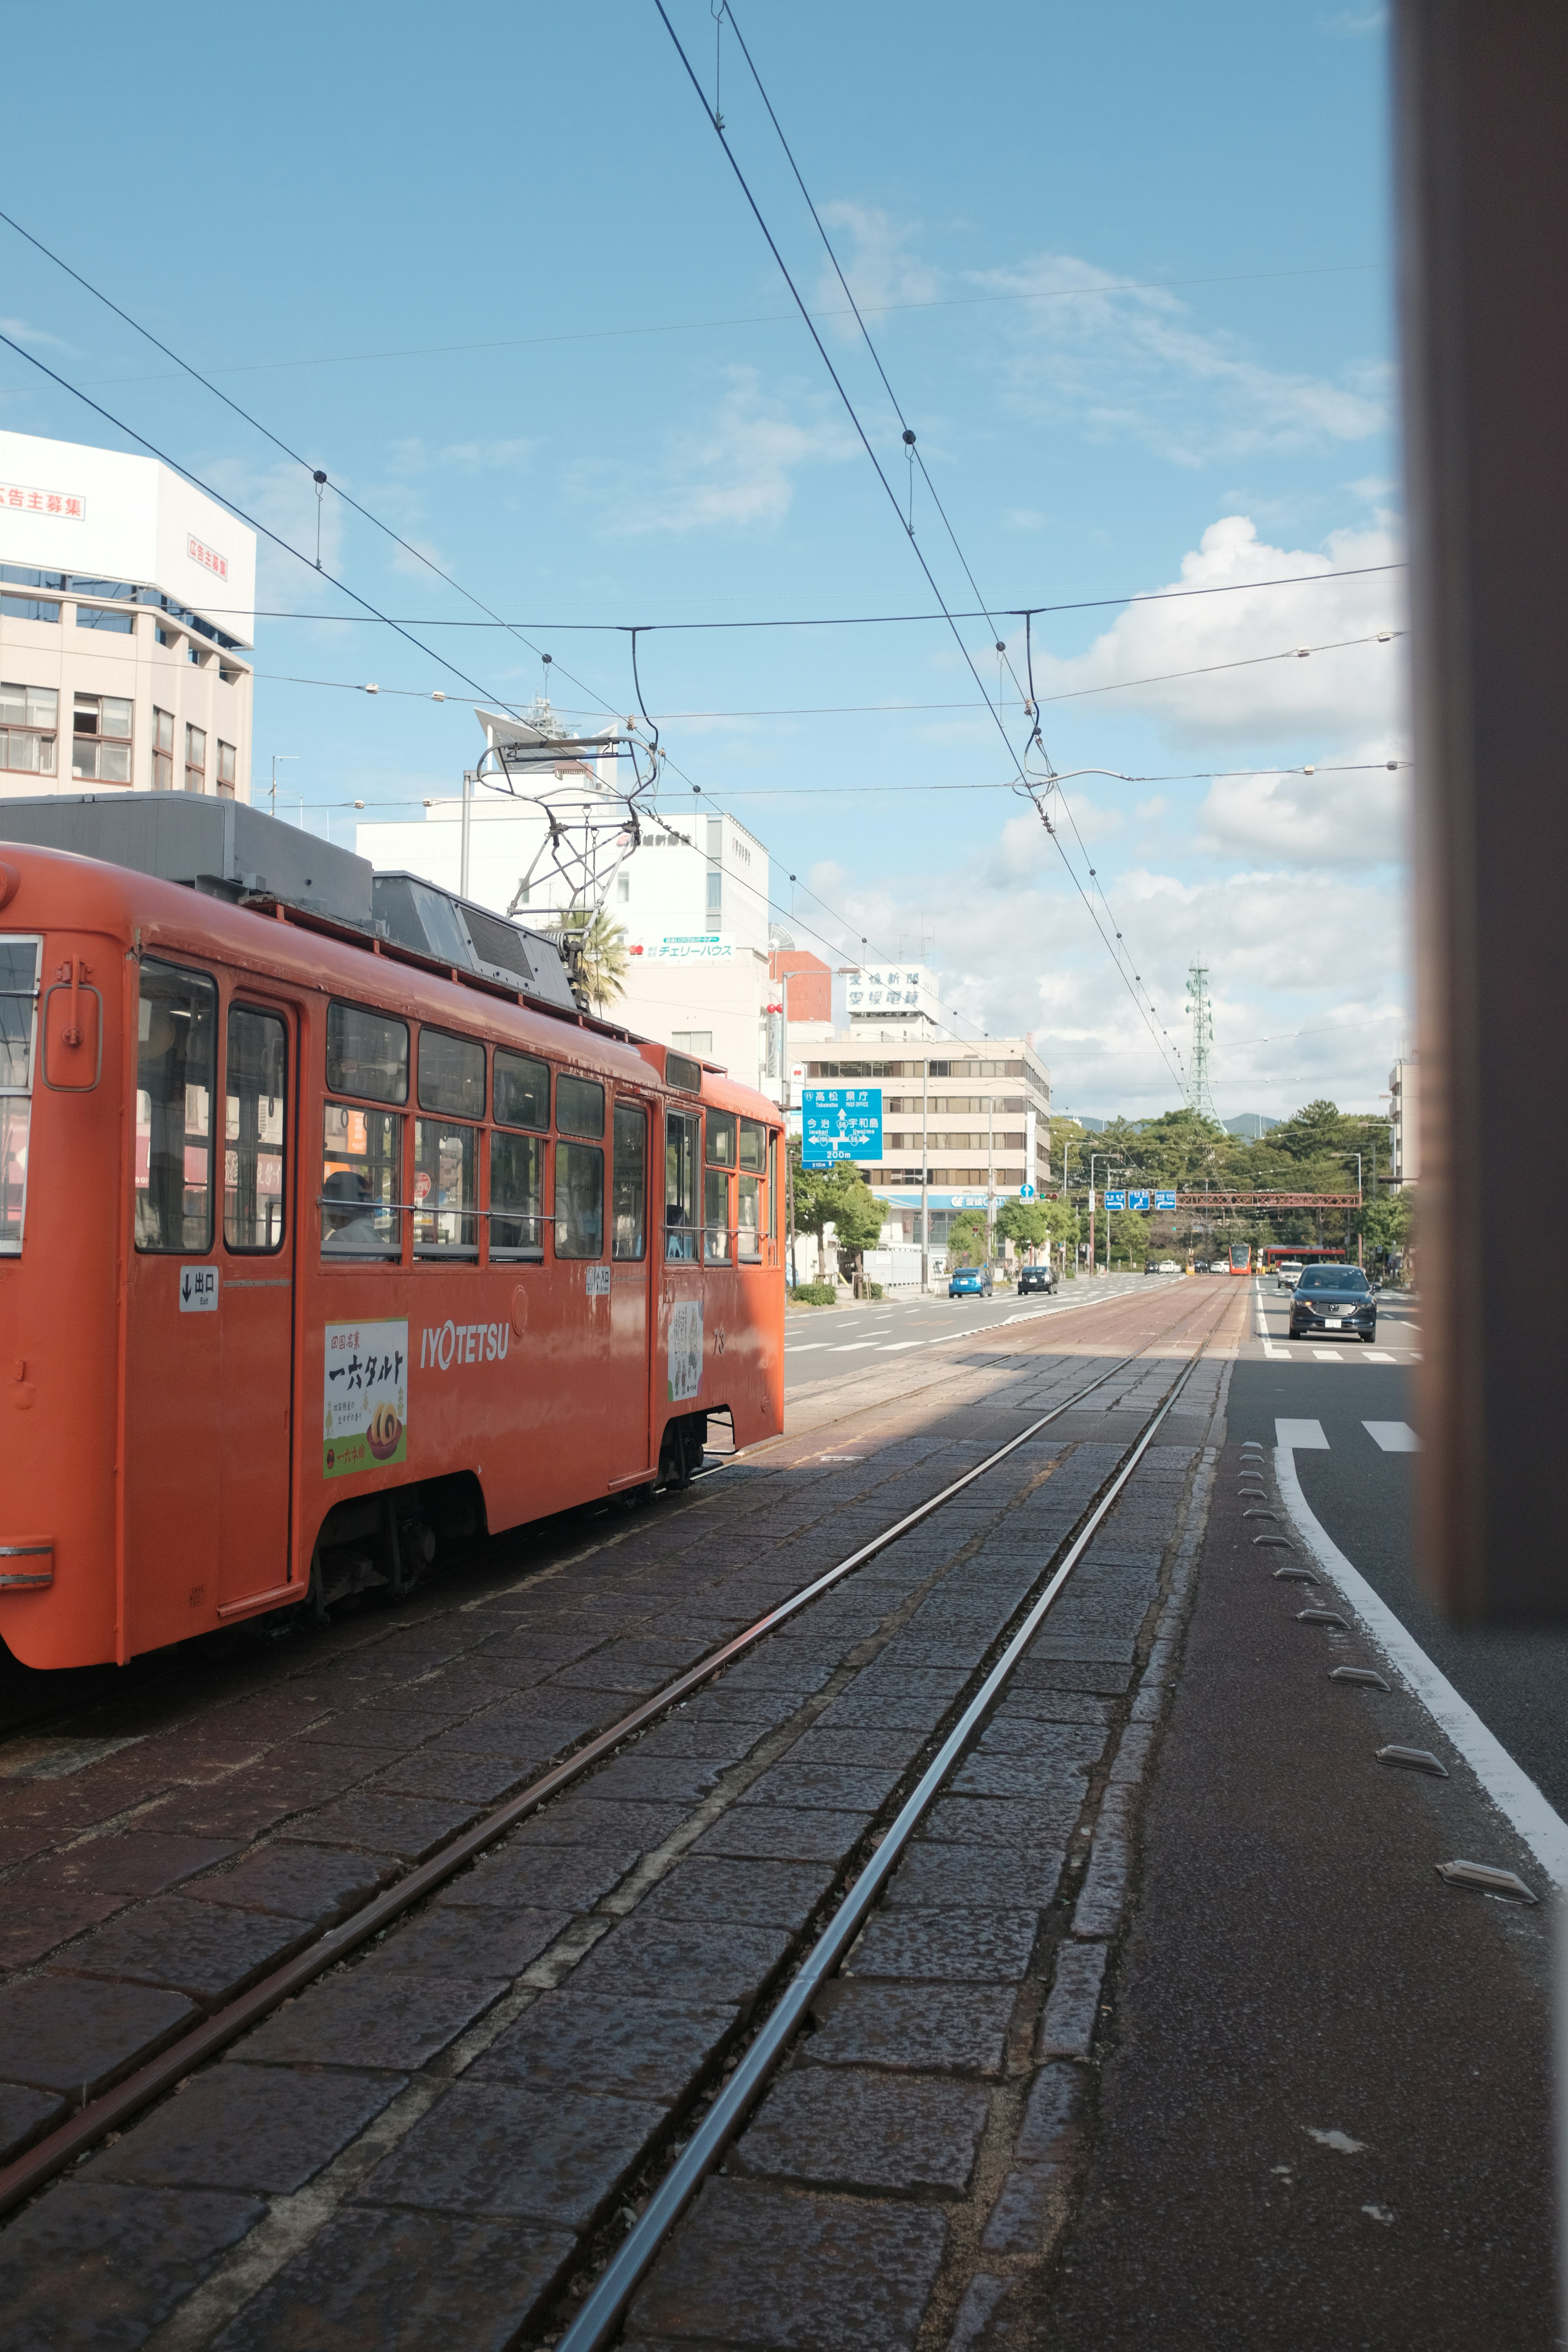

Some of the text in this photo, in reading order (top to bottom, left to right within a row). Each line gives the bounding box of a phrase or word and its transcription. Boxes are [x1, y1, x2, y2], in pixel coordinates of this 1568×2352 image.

[190, 540, 226, 577] 広告主募集
[630, 834, 692, 847] 媛新聞社
[659, 946, 731, 957] チェリーハウス
[816, 1091, 838, 1101] 高松
[846, 1091, 868, 1101] 県庁
[807, 1118, 830, 1129] 今治
[848, 1118, 879, 1128] 宇和島
[195, 1272, 214, 1294] 出口
[601, 1271, 608, 1283] 入口
[331, 1330, 359, 1350] 四国名菓
[420, 1320, 509, 1371] IYOTETSU
[329, 1350, 403, 1391] 一六タルト
[333, 1401, 354, 1411] 四国特産の
[338, 1412, 361, 1424] 生ゆずの香り
[337, 1443, 365, 1464] 一六本舗
